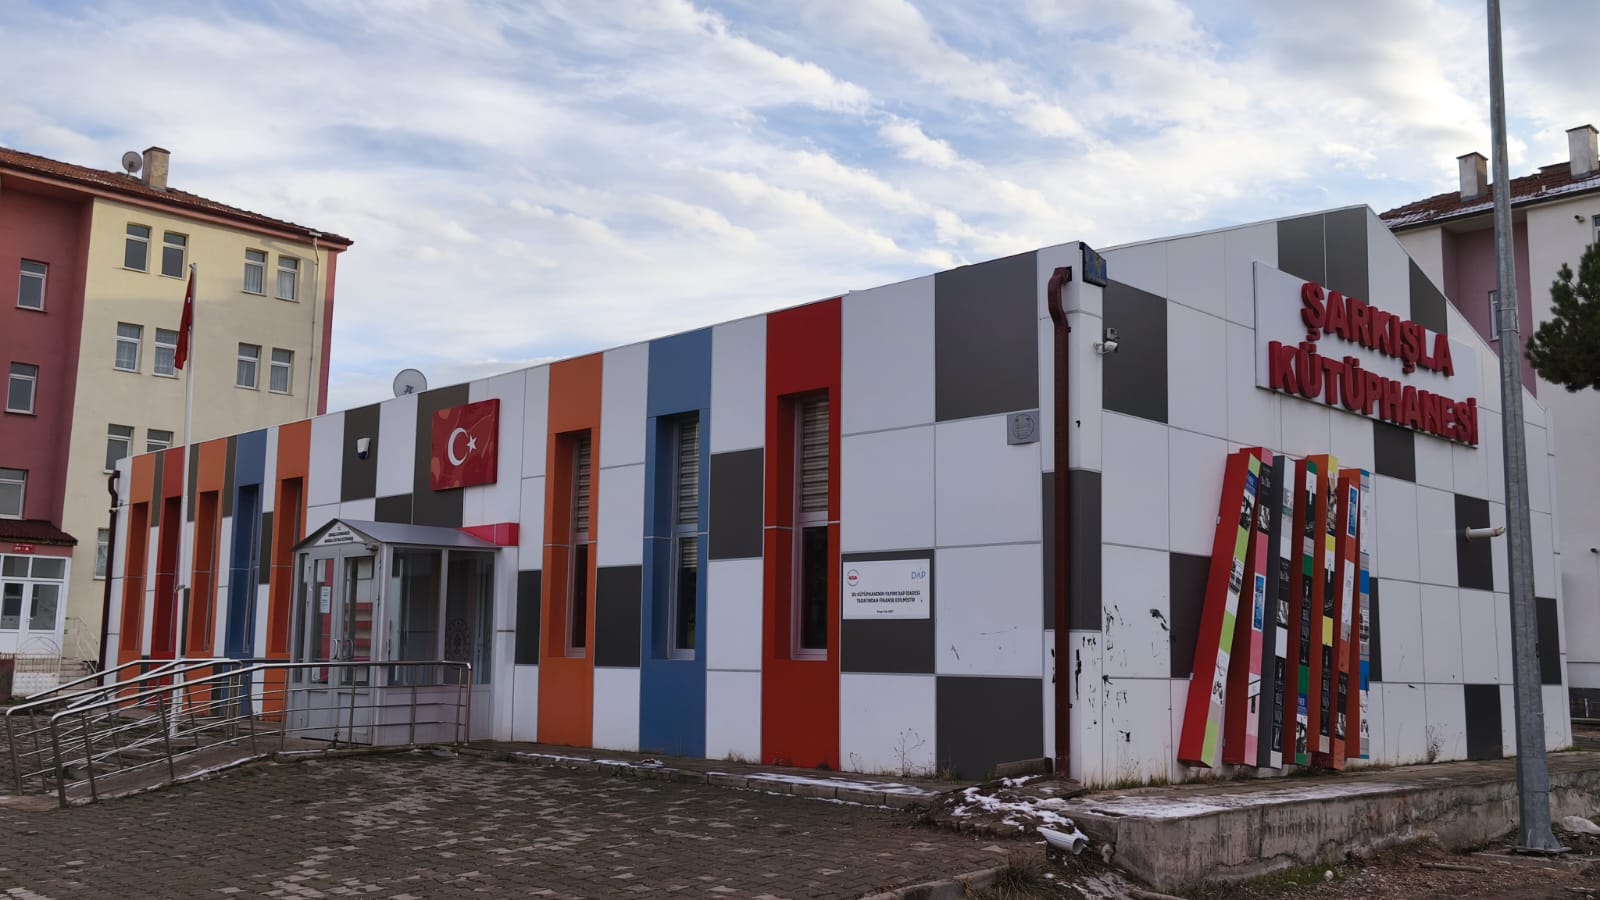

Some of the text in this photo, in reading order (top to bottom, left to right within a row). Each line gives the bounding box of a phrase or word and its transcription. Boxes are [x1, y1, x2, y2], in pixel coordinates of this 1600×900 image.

[1301, 281, 1455, 377] ŞARKIŞLA
[1268, 340, 1478, 445] KÜTÜPHANESİ
[911, 570, 927, 580] DAP
